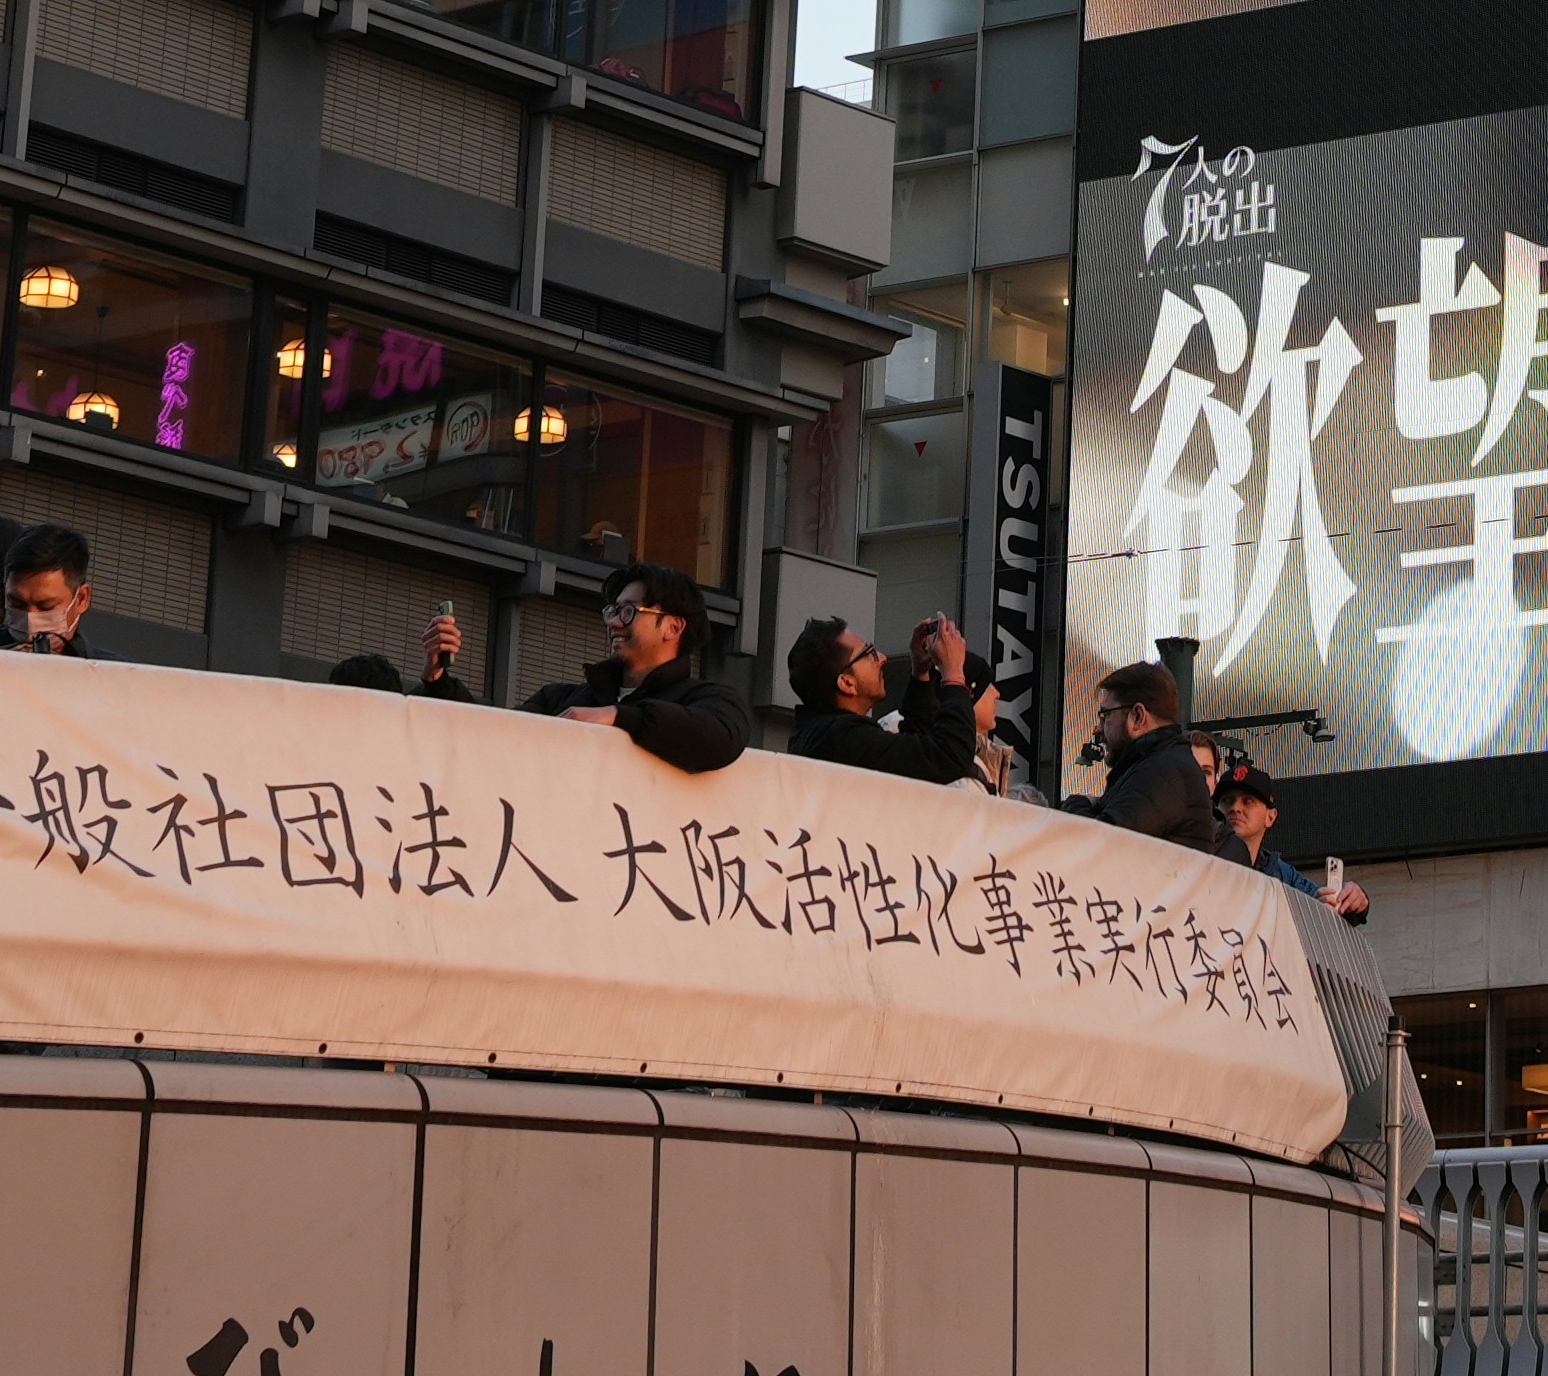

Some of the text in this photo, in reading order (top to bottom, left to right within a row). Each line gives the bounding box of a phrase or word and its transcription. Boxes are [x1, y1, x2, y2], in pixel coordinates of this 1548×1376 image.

[602, 798, 1303, 1040] 大阪活性化事業実行委員会
